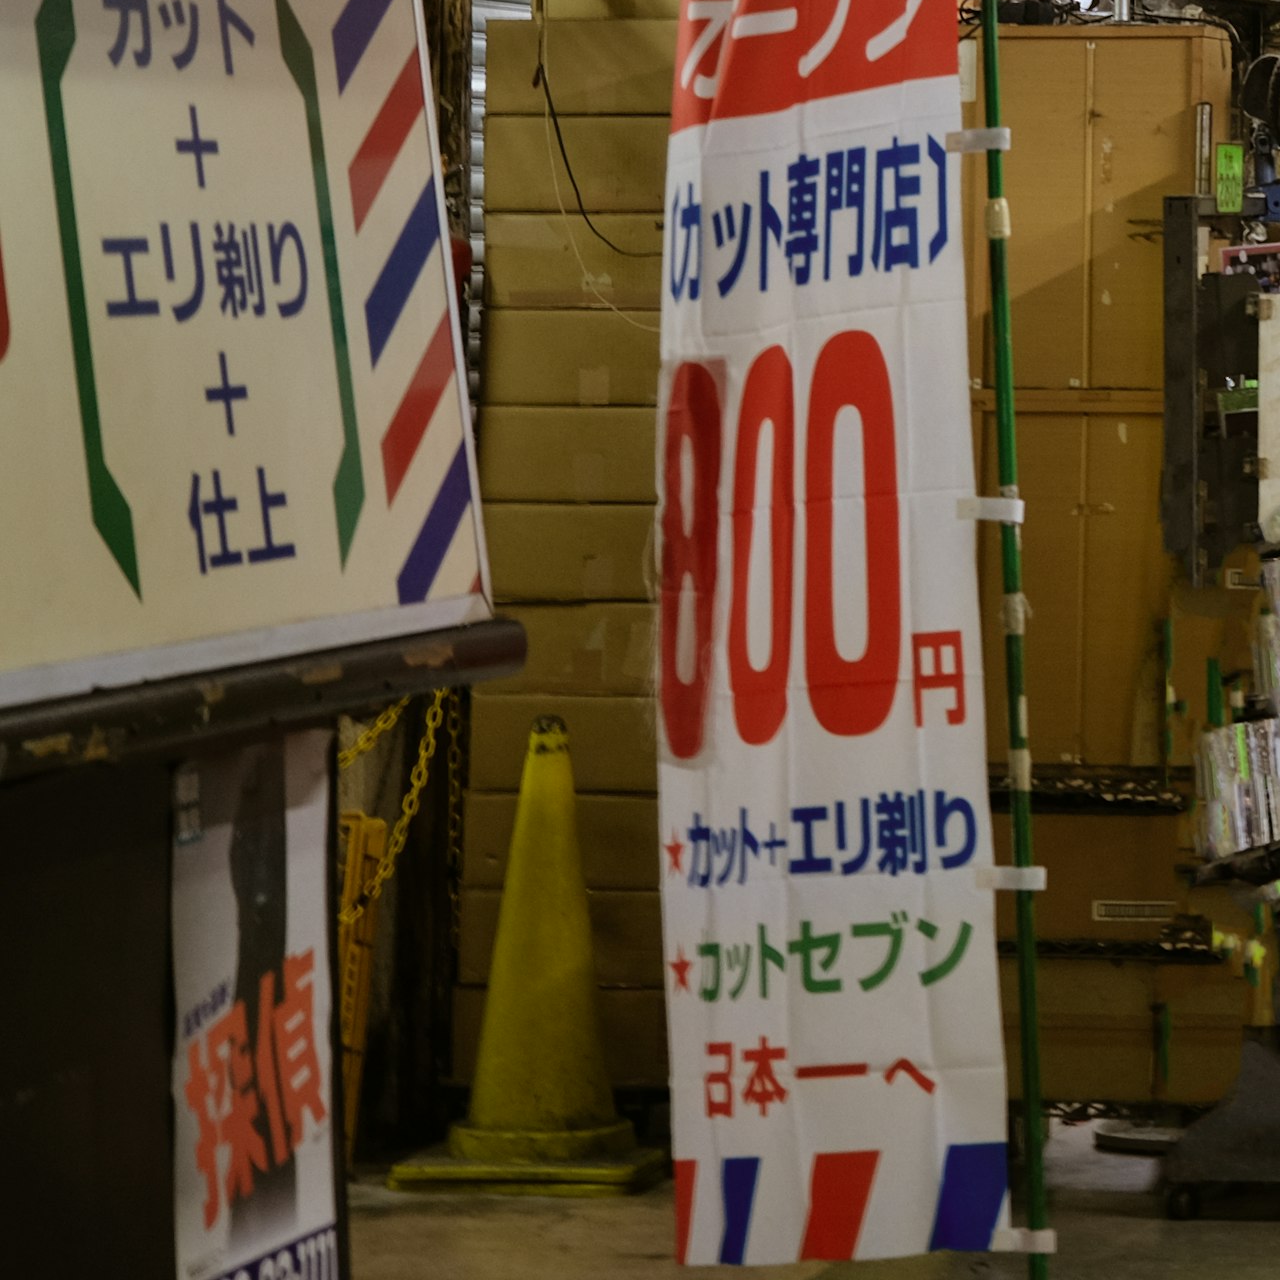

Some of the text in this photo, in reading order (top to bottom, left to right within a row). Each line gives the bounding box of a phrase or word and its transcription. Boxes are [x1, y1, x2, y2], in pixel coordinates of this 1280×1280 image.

[101, 221, 309, 322] エリ剃り
[188, 467, 296, 575] 仕上
[184, 946, 326, 1231] 探偵
[703, 1035, 936, 1118] 日本一へ
